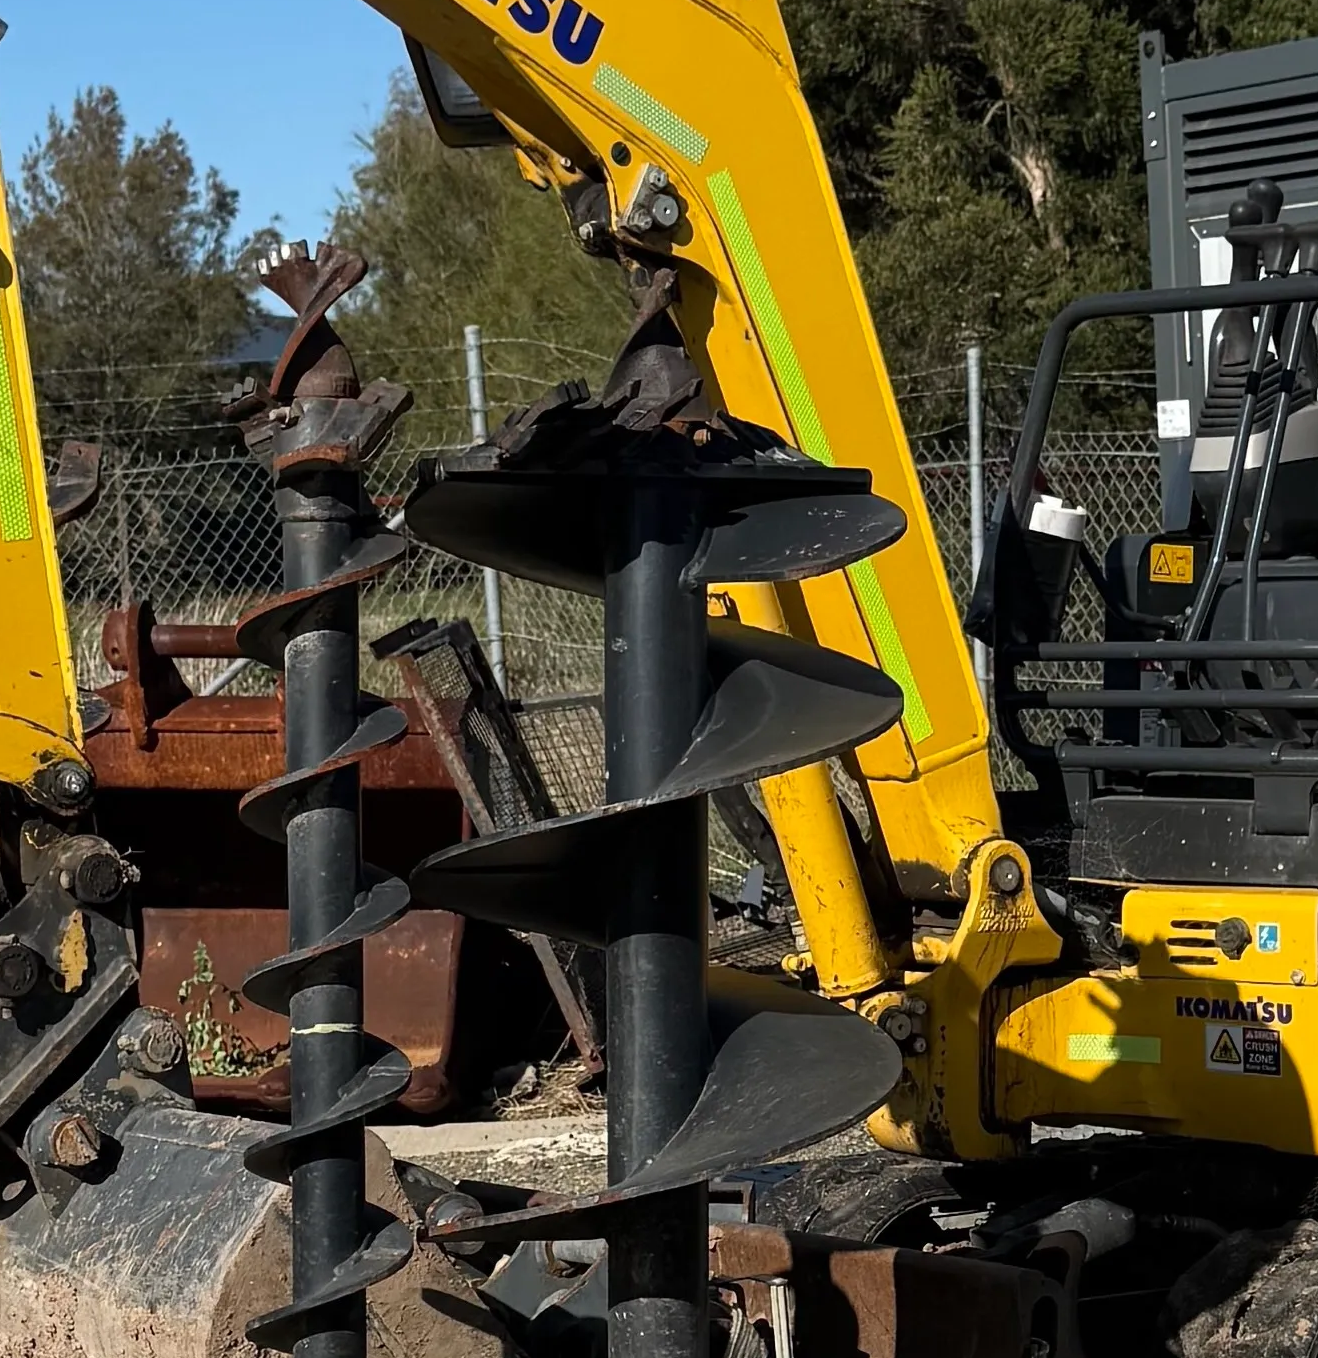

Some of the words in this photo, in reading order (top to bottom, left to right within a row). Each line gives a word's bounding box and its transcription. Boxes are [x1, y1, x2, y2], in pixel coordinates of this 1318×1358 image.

[1175, 995, 1293, 1024] KOMATSU
[1244, 1041, 1278, 1053] CRUSH
[1248, 1053, 1274, 1064] ZONE
